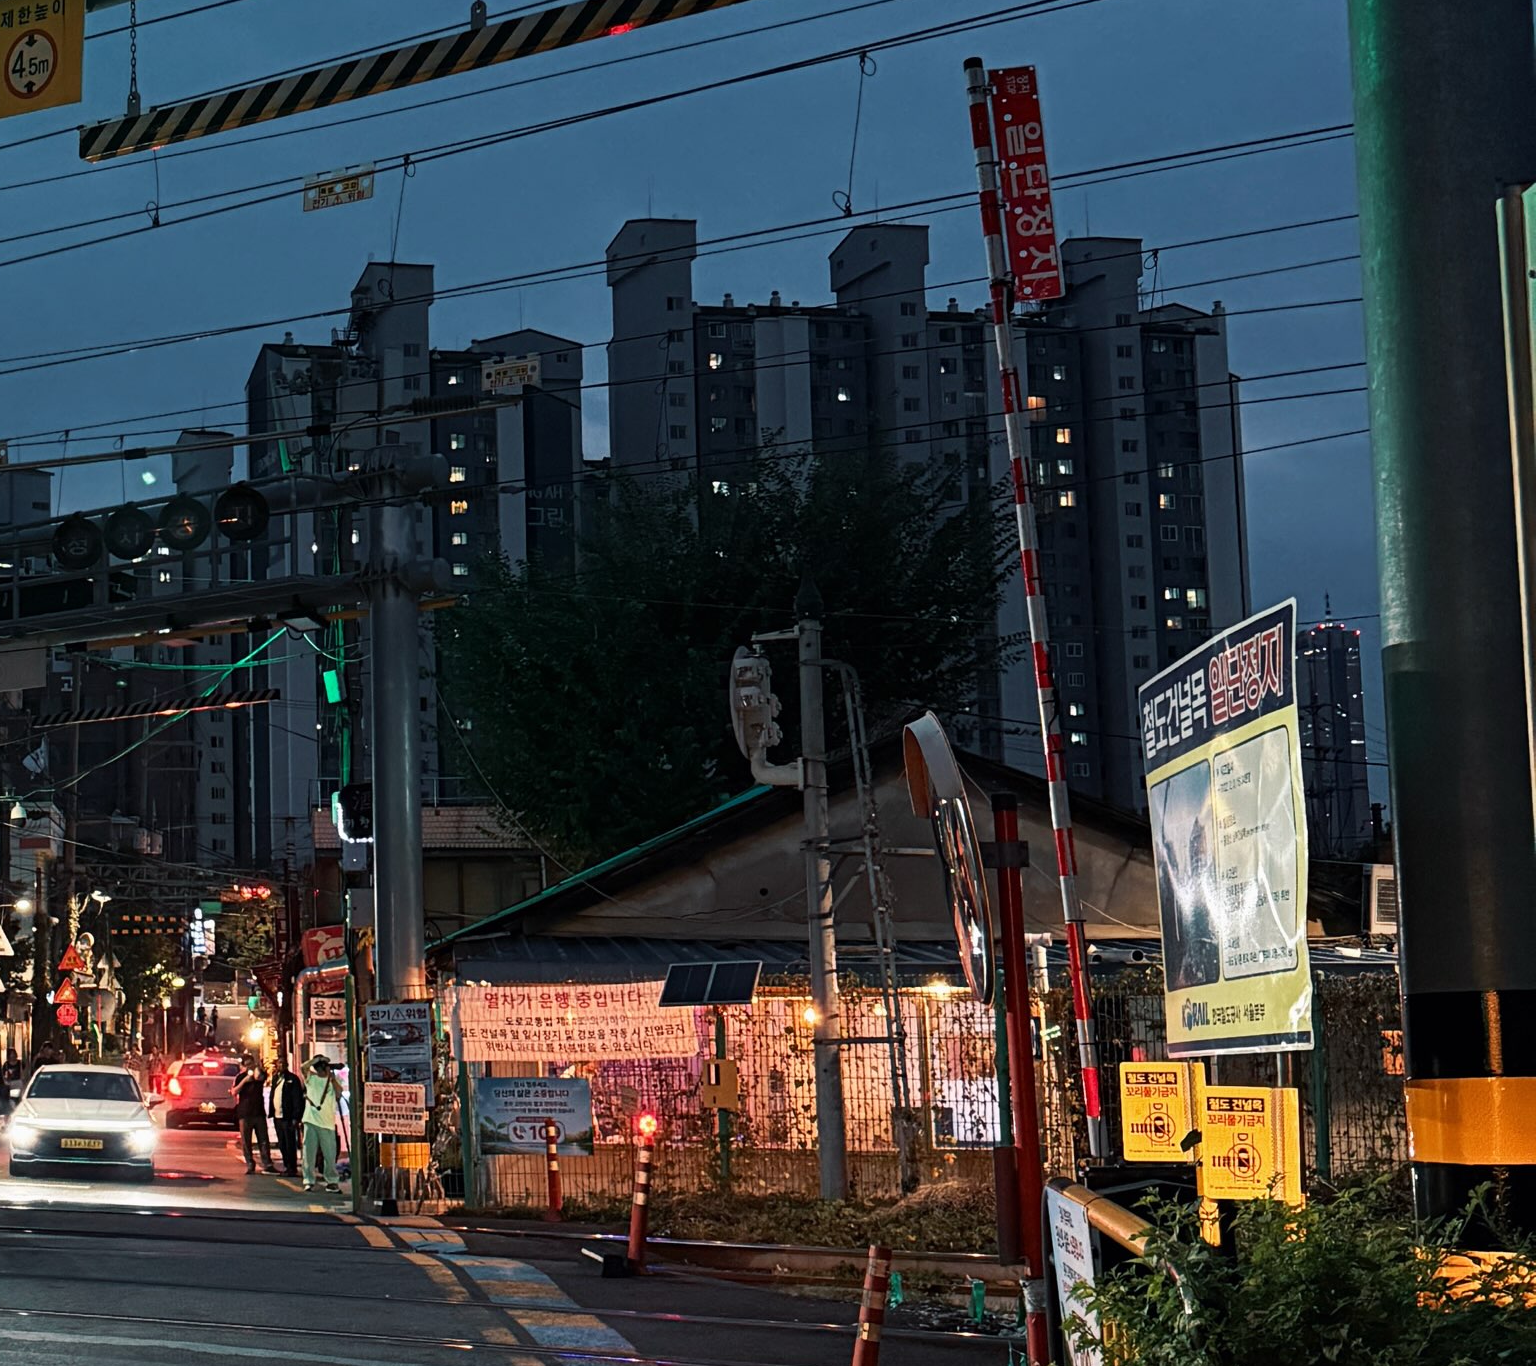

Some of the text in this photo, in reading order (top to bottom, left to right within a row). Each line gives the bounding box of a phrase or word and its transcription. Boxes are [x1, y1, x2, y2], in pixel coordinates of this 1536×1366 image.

[11, 50, 50, 79] 4.5m
[1004, 121, 1059, 281] 일단정지
[1143, 622, 1285, 760] 철도건널목 일단정지
[484, 989, 649, 1010] 열차가 운행 중입니다.
[312, 999, 342, 1017] 용산
[369, 1008, 427, 1021] 전기 위험
[505, 1016, 553, 1028] 도로교통법
[481, 1028, 507, 1040] 건널목
[522, 1029, 562, 1042] 일시정지
[632, 1026, 641, 1040] 시
[644, 1023, 685, 1038] 진입금지
[1126, 1073, 1176, 1085] 철도 건널목
[371, 1090, 418, 1105] 출입금지
[1126, 1086, 1178, 1099] 꼬리물기금지
[1208, 1098, 1263, 1112] 철도 건널목
[1207, 1113, 1266, 1128] 꼬리물기금지
